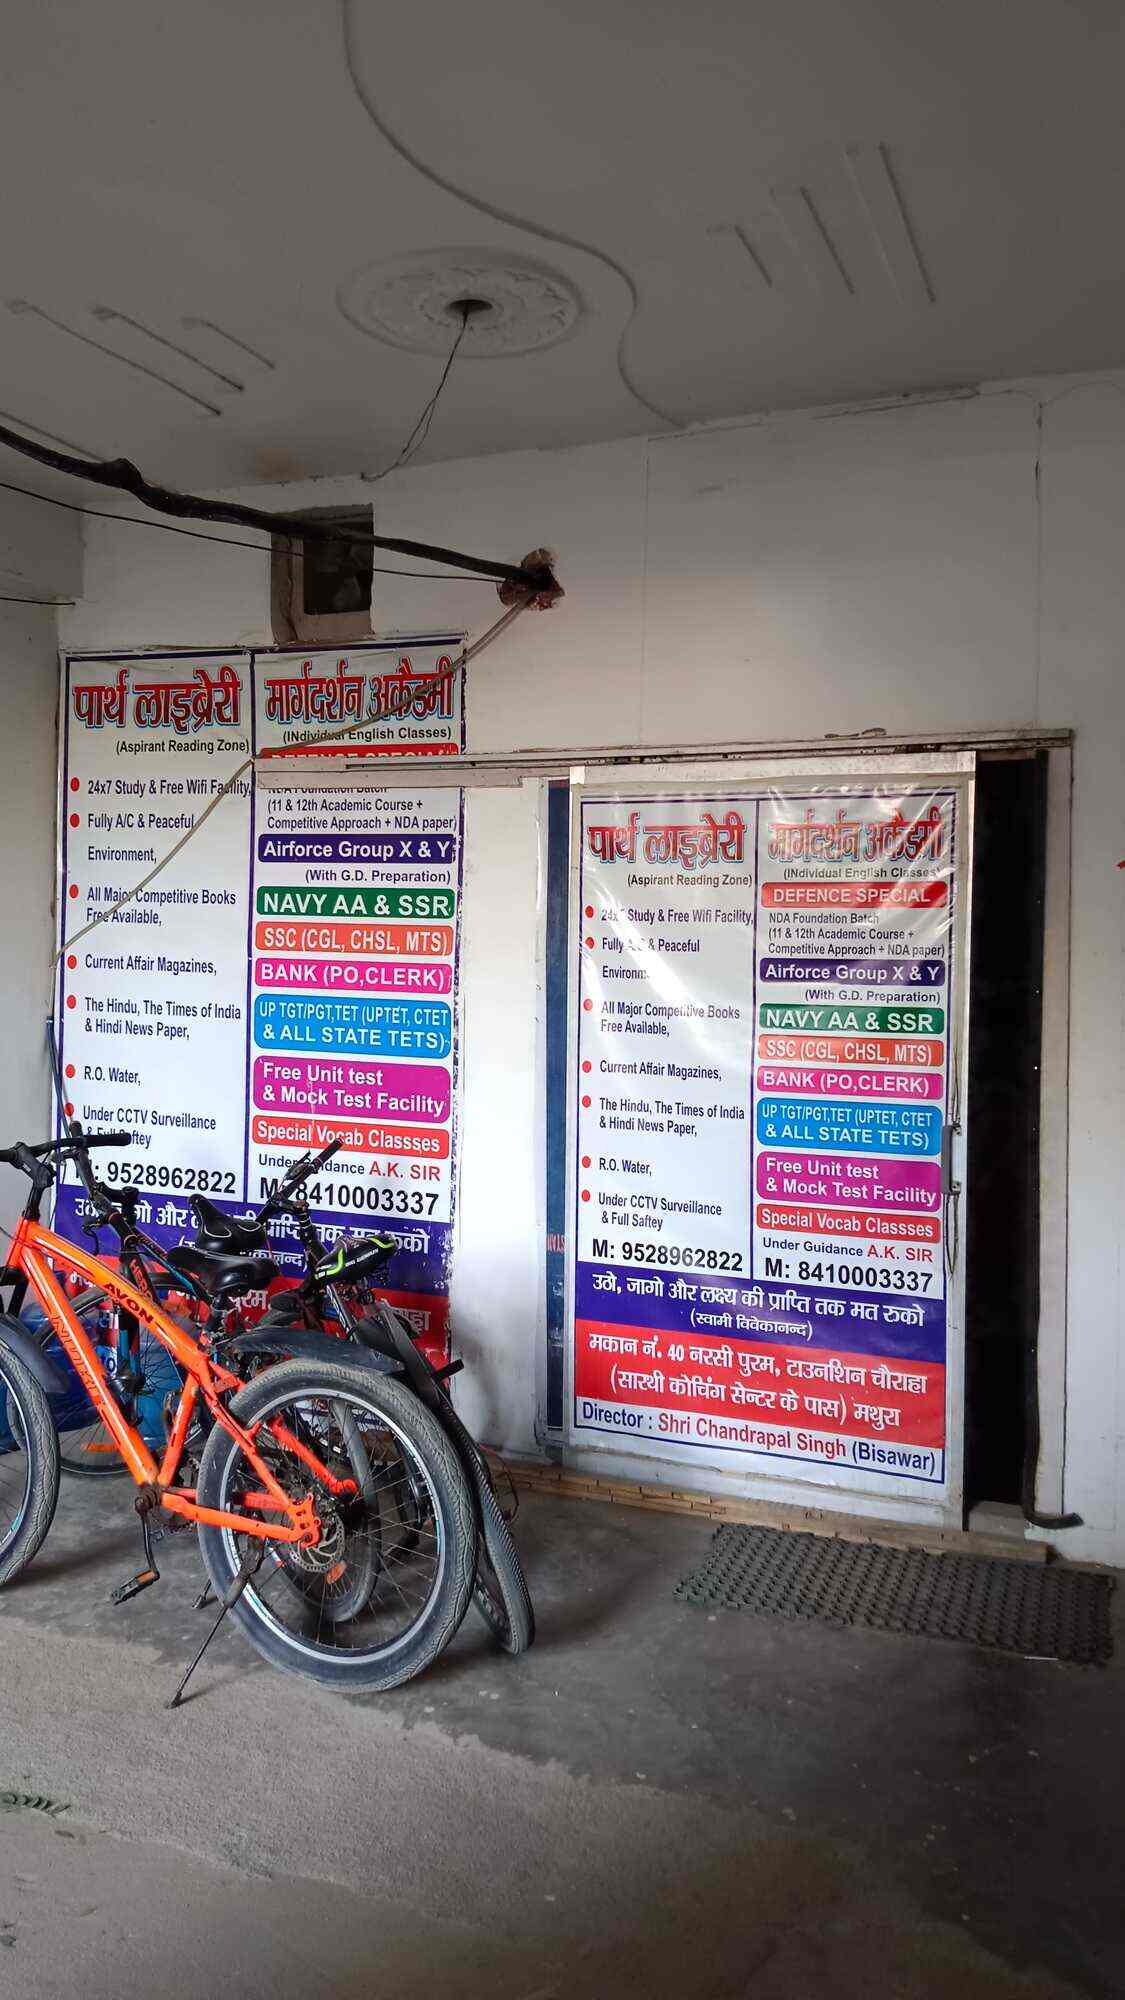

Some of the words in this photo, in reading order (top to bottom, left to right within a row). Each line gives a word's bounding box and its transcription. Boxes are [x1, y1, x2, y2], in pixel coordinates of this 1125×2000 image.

[73, 668, 128, 728] पार्थ
[133, 665, 243, 735] लाइब्रेरी
[265, 660, 365, 724] मार्गदर्शन
[116, 740, 166, 754] (Aspirant
[169, 739, 214, 756] Reading
[217, 738, 250, 755] Zone)
[88, 814, 112, 832] Fully
[116, 814, 134, 828] A/C
[138, 814, 145, 828] &
[149, 814, 194, 829] Peaceful
[264, 841, 333, 858] Airforce
[338, 841, 394, 860] Group
[399, 841, 411, 856] X
[418, 841, 431, 856] &
[436, 841, 452, 856] Y
[587, 812, 640, 863] पार्थ
[644, 812, 747, 870] लाइब्रेरी
[88, 846, 157, 864] Environment,
[305, 869, 338, 883] (With
[341, 870, 367, 882] G.D.
[371, 869, 451, 885] Preparation)
[628, 875, 674, 886] (Aspirant
[677, 875, 719, 887] Reading
[723, 875, 752, 887] Zone)
[784, 868, 841, 879] (INdividual
[846, 868, 887, 880] English
[264, 894, 326, 914] NAVY
[333, 895, 368, 915] AA
[374, 895, 390, 915] &
[399, 895, 449, 916] SSR
[774, 889, 850, 902] DEFENCE
[856, 888, 930, 902] SPECIAL
[769, 913, 790, 923] NDA
[793, 913, 847, 923] Foundation
[851, 913, 878, 923] Batch
[264, 929, 296, 946] SSC
[302, 929, 345, 952] (CGL,
[350, 931, 400, 952] CHSL,
[406, 932, 447, 956] MTS)
[769, 928, 781, 941] (11
[785, 928, 791, 938] &
[796, 928, 814, 938] 12th
[818, 928, 865, 939] Academic
[869, 929, 904, 939] Course
[769, 943, 825, 956] Competitive
[828, 944, 875, 956] Approach
[888, 945, 909, 955] NDA
[913, 944, 944, 958] paper)
[85, 955, 123, 970] Current
[126, 956, 154, 972] Affair
[157, 957, 217, 975] Magazines,
[262, 963, 316, 983] BANK
[323, 965, 444, 988] (PO,CLERK)
[805, 989, 833, 1003] (With
[838, 990, 864, 1002] G.D.
[867, 990, 940, 1004] Preparation)
[85, 997, 103, 1013] The
[107, 998, 140, 1017] Hindu,
[143, 1000, 162, 1015] The
[166, 1001, 198, 1018] Times
[202, 1003, 212, 1018] of
[214, 1003, 241, 1019] India
[602, 1001, 614, 1017] All
[617, 1002, 642, 1021] Major
[707, 1005, 740, 1020] Books
[85, 1019, 92, 1032] &
[96, 1018, 123, 1034] Hindi
[126, 1021, 154, 1037] News
[156, 1022, 190, 1040] Paper,
[601, 1019, 623, 1033] Free
[626, 1021, 669, 1037] Available,
[84, 1065, 105, 1081] R.O.
[109, 1066, 141, 1085] Water,
[264, 1063, 302, 1082] Free
[308, 1066, 343, 1083] Unit
[349, 1068, 383, 1086] test
[764, 1072, 814, 1089] BANK
[820, 1073, 929, 1096] (PO,CLERK)
[83, 1105, 113, 1123] Under
[117, 1109, 148, 1126] CCTV
[151, 1111, 216, 1130] Surveillance
[762, 1104, 779, 1118] UP
[855, 1106, 899, 1125] (UPTET,
[901, 1109, 932, 1126] CTET
[258, 1121, 313, 1143] Special
[367, 1128, 440, 1153] Classses
[766, 1123, 777, 1137] &
[783, 1125, 814, 1140] ALL
[820, 1127, 875, 1145] STATE
[880, 1129, 929, 1149] TETS)
[107, 1161, 235, 1194] 9528962822
[766, 1157, 802, 1175] Free
[808, 1160, 842, 1177] Unit
[847, 1163, 879, 1179] test
[296, 1181, 438, 1215] 8410003337
[766, 1177, 777, 1191] &
[783, 1178, 827, 1195] Mock
[833, 1181, 869, 1199] Test
[873, 1185, 936, 1206] Facility
[602, 1211, 609, 1224] &
[611, 1211, 629, 1226] Full
[632, 1213, 663, 1231] Saftey
[762, 1208, 813, 1228] Special
[816, 1213, 861, 1231] Vocab
[865, 1216, 933, 1237] Classses
[592, 1239, 615, 1258] M:
[622, 1241, 743, 1272] 9528962822
[763, 1237, 799, 1252] Under
[803, 1240, 863, 1257] Guidance
[867, 1245, 900, 1259] A.K.
[906, 1246, 932, 1262] SIR
[765, 1258, 790, 1279] M:
[798, 1260, 933, 1293] 8410003337
[104, 1282, 155, 1324] AVON
[592, 1271, 621, 1294] उठो,
[627, 1276, 664, 1297] जागो
[669, 1279, 698, 1301] और
[701, 1287, 736, 1305] लक्ष्य
[742, 1286, 765, 1308] की
[768, 1290, 811, 1313] प्राप्ति
[815, 1298, 846, 1316] तक
[850, 1301, 879, 1321] मत
[691, 1308, 732, 1327] (स्वामी
[589, 1333, 638, 1355] मकान
[668, 1344, 684, 1361] 40
[689, 1344, 733, 1368] नरसी
[737, 1350, 781, 1378] पुरम,
[871, 1365, 927, 1394] चौराहा
[669, 1374, 726, 1401] कोचिंग
[730, 1381, 777, 1408] सेन्टर
[780, 1389, 799, 1412] के
[804, 1393, 846, 1425] पास)
[854, 1403, 901, 1431] मथुरा
[583, 1401, 643, 1428] Director
[659, 1413, 690, 1435] Shri
[696, 1417, 791, 1449] Chandrapal
[797, 1432, 846, 1460] Singh
[853, 1441, 935, 1476] (Bisawar)
